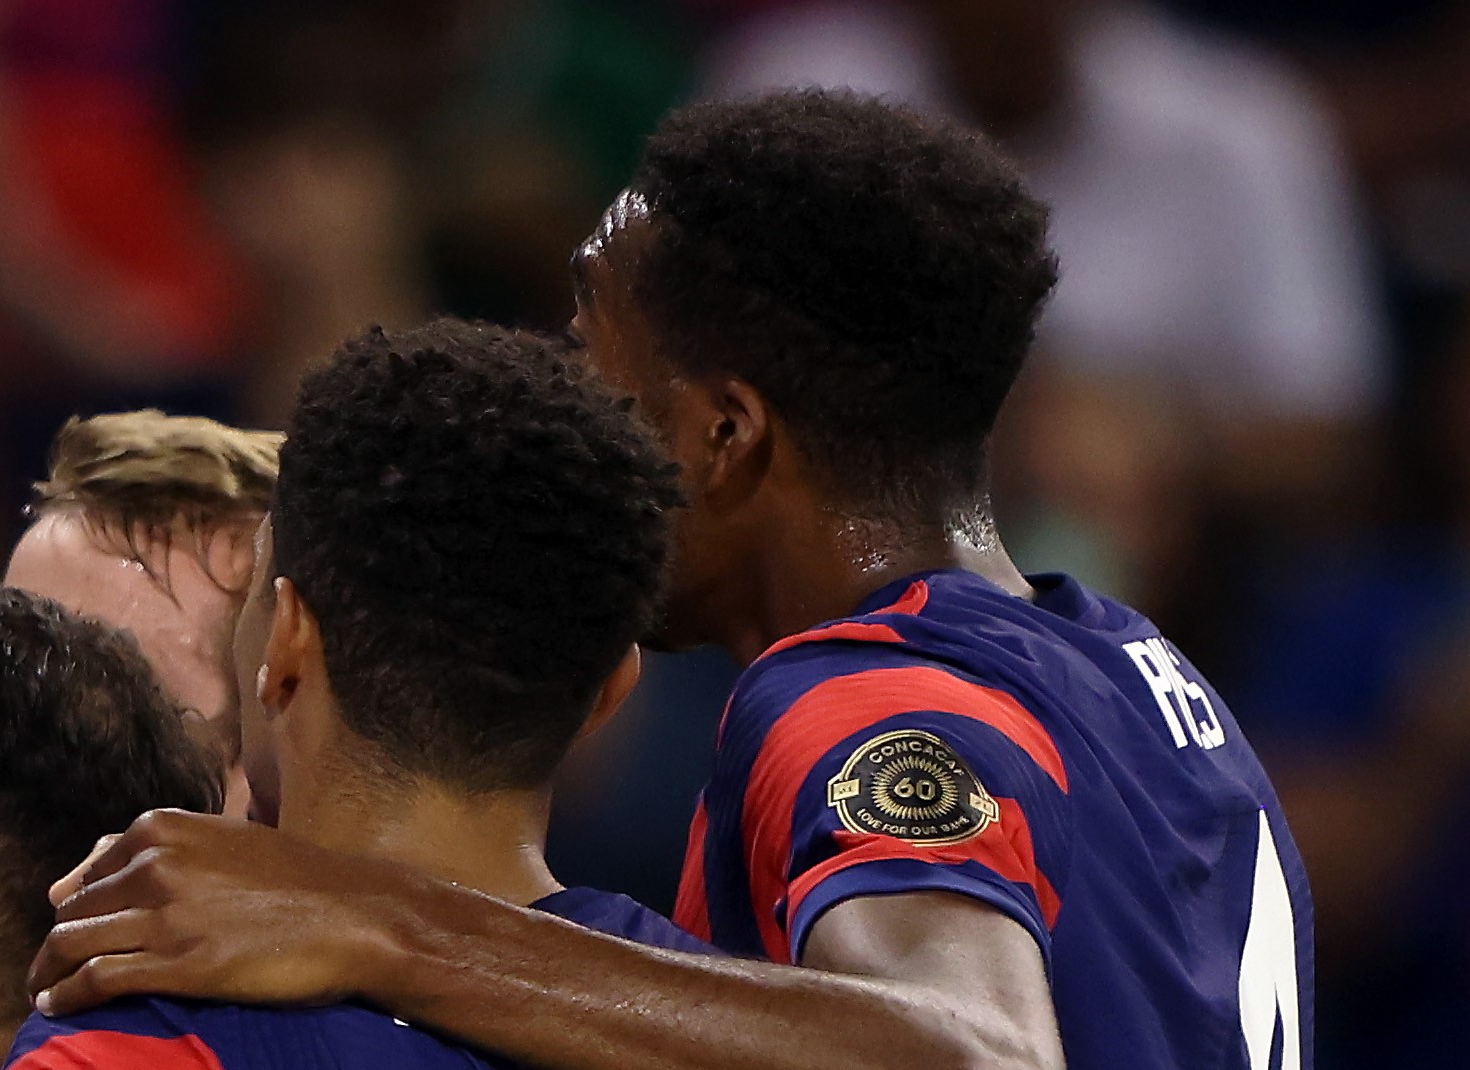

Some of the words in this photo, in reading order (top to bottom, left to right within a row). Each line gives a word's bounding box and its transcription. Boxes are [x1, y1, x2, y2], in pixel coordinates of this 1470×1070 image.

[868, 741, 965, 776] CONCACAF
[893, 777, 936, 800] 60
[856, 808, 882, 829] LOVE
[882, 823, 908, 834] FOR
[911, 825, 938, 835] OUR
[940, 815, 970, 832] GAME
